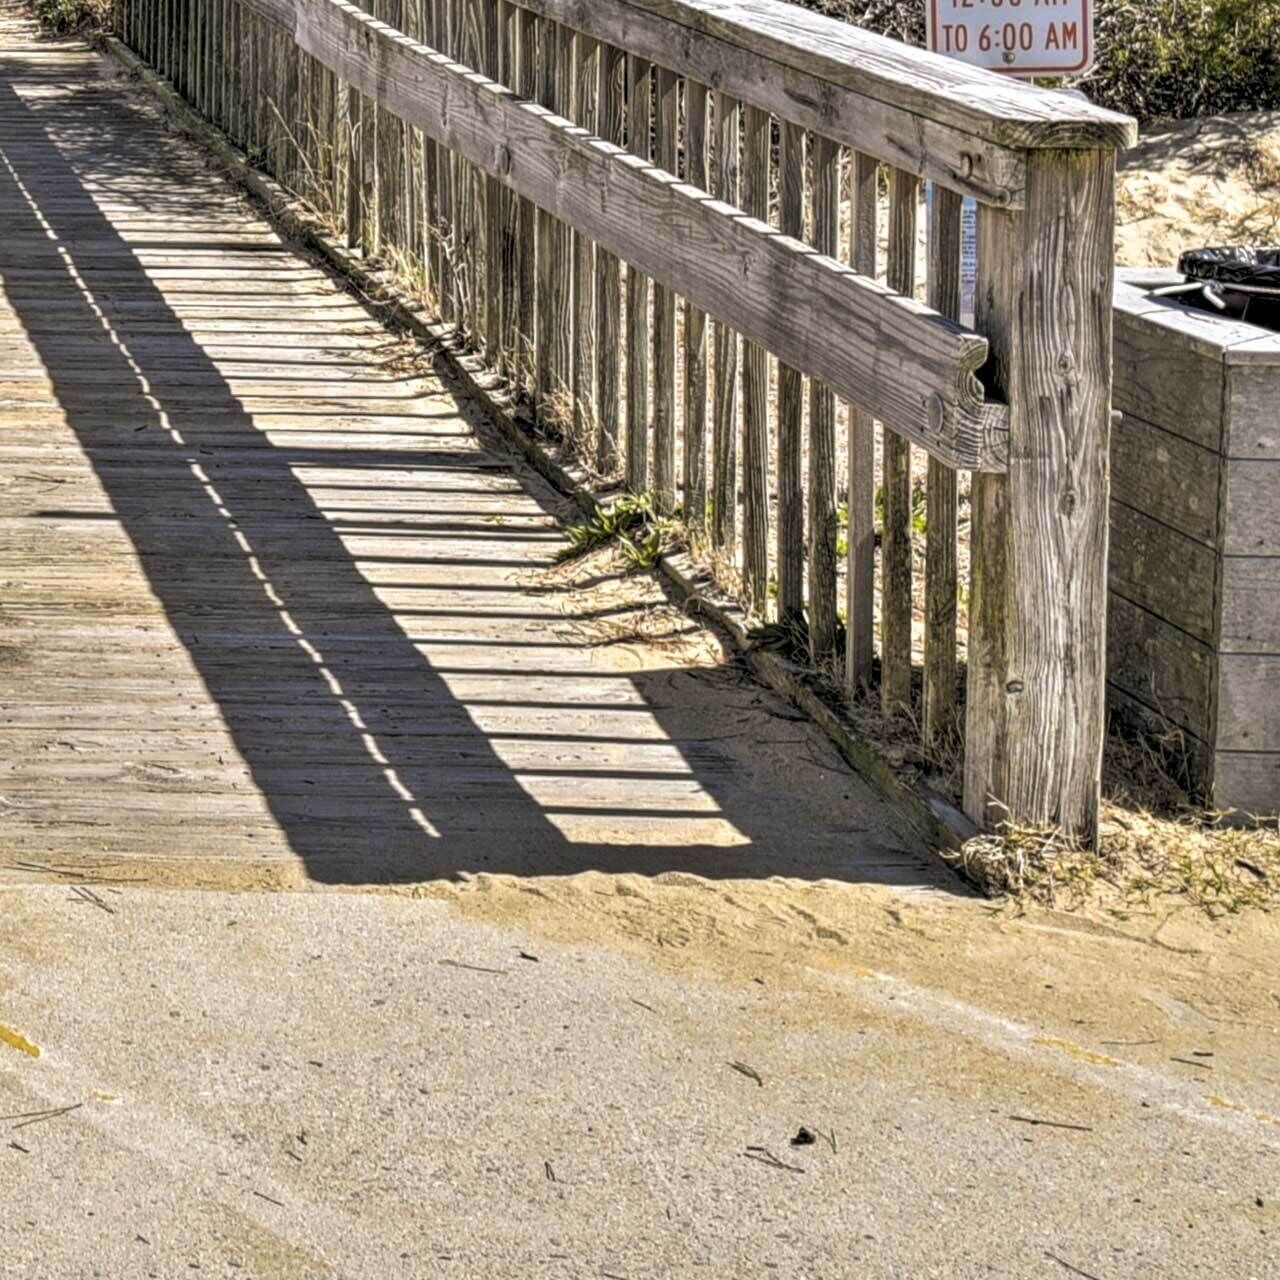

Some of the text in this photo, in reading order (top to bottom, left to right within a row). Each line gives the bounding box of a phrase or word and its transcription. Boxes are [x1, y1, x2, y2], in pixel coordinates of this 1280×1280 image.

[941, 21, 1078, 53] TO 6:00 AM
